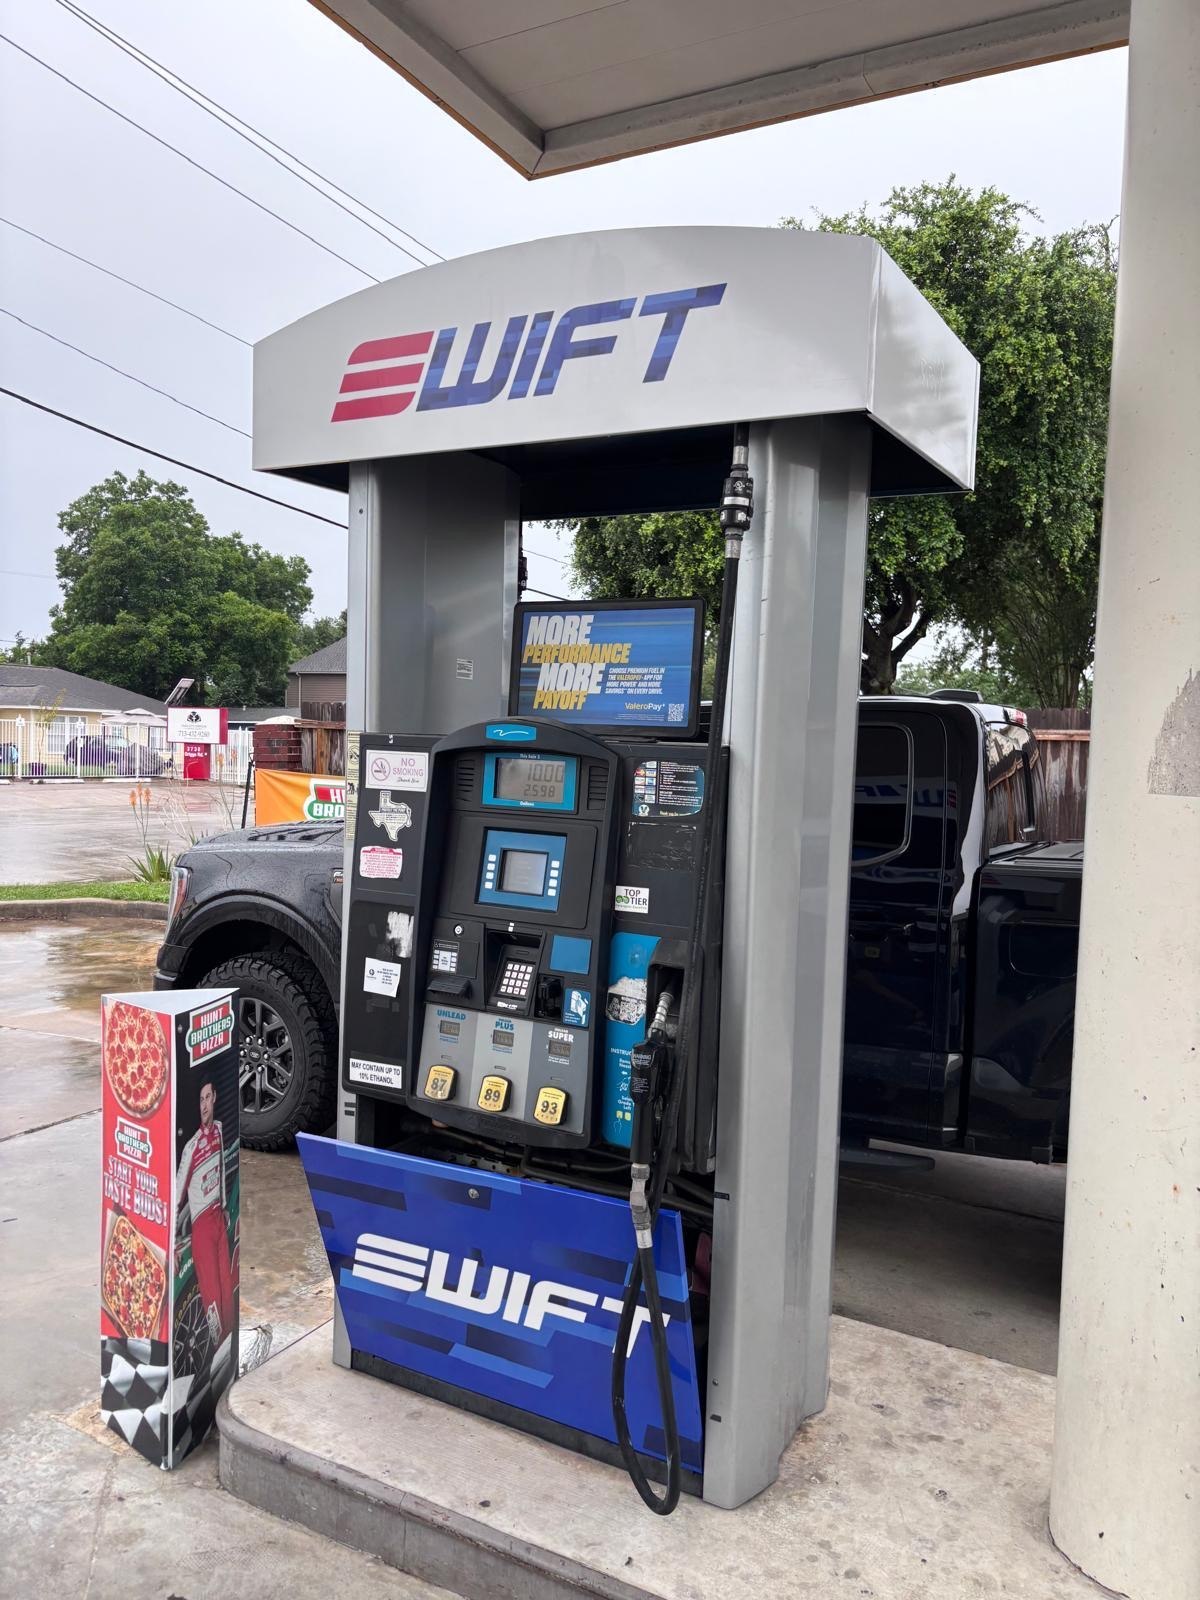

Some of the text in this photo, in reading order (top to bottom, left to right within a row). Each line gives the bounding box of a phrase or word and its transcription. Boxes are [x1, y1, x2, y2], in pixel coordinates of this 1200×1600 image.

[526, 614, 594, 646] MORE
[522, 643, 632, 664] PERFORMANCE
[537, 662, 607, 694] MORE
[533, 690, 589, 710] PAYOFF
[400, 758, 416, 767] NO
[392, 767, 424, 777] SMOKING
[624, 888, 641, 897] TOP
[630, 897, 648, 906] TIER
[201, 1007, 223, 1027] HUNT
[437, 1009, 466, 1021] UNLEAD
[190, 1016, 231, 1046] BROTHERS
[495, 1021, 514, 1031] PLUS
[548, 1030, 574, 1043] SUPER
[200, 1035, 224, 1054] PIZZA
[351, 1061, 401, 1076] MAY CONTAIN UP TO
[359, 1072, 394, 1085] 10% ETHANOL
[431, 1078, 447, 1091] 87
[484, 1088, 501, 1102] 89
[540, 1100, 558, 1115] 93
[124, 1126, 141, 1142] HUNT
[118, 1133, 149, 1153] BROTHERS
[123, 1143, 142, 1160] PIZZA
[108, 1156, 158, 1196] START YOUR
[104, 1173, 167, 1226] TASTE BUDS!
